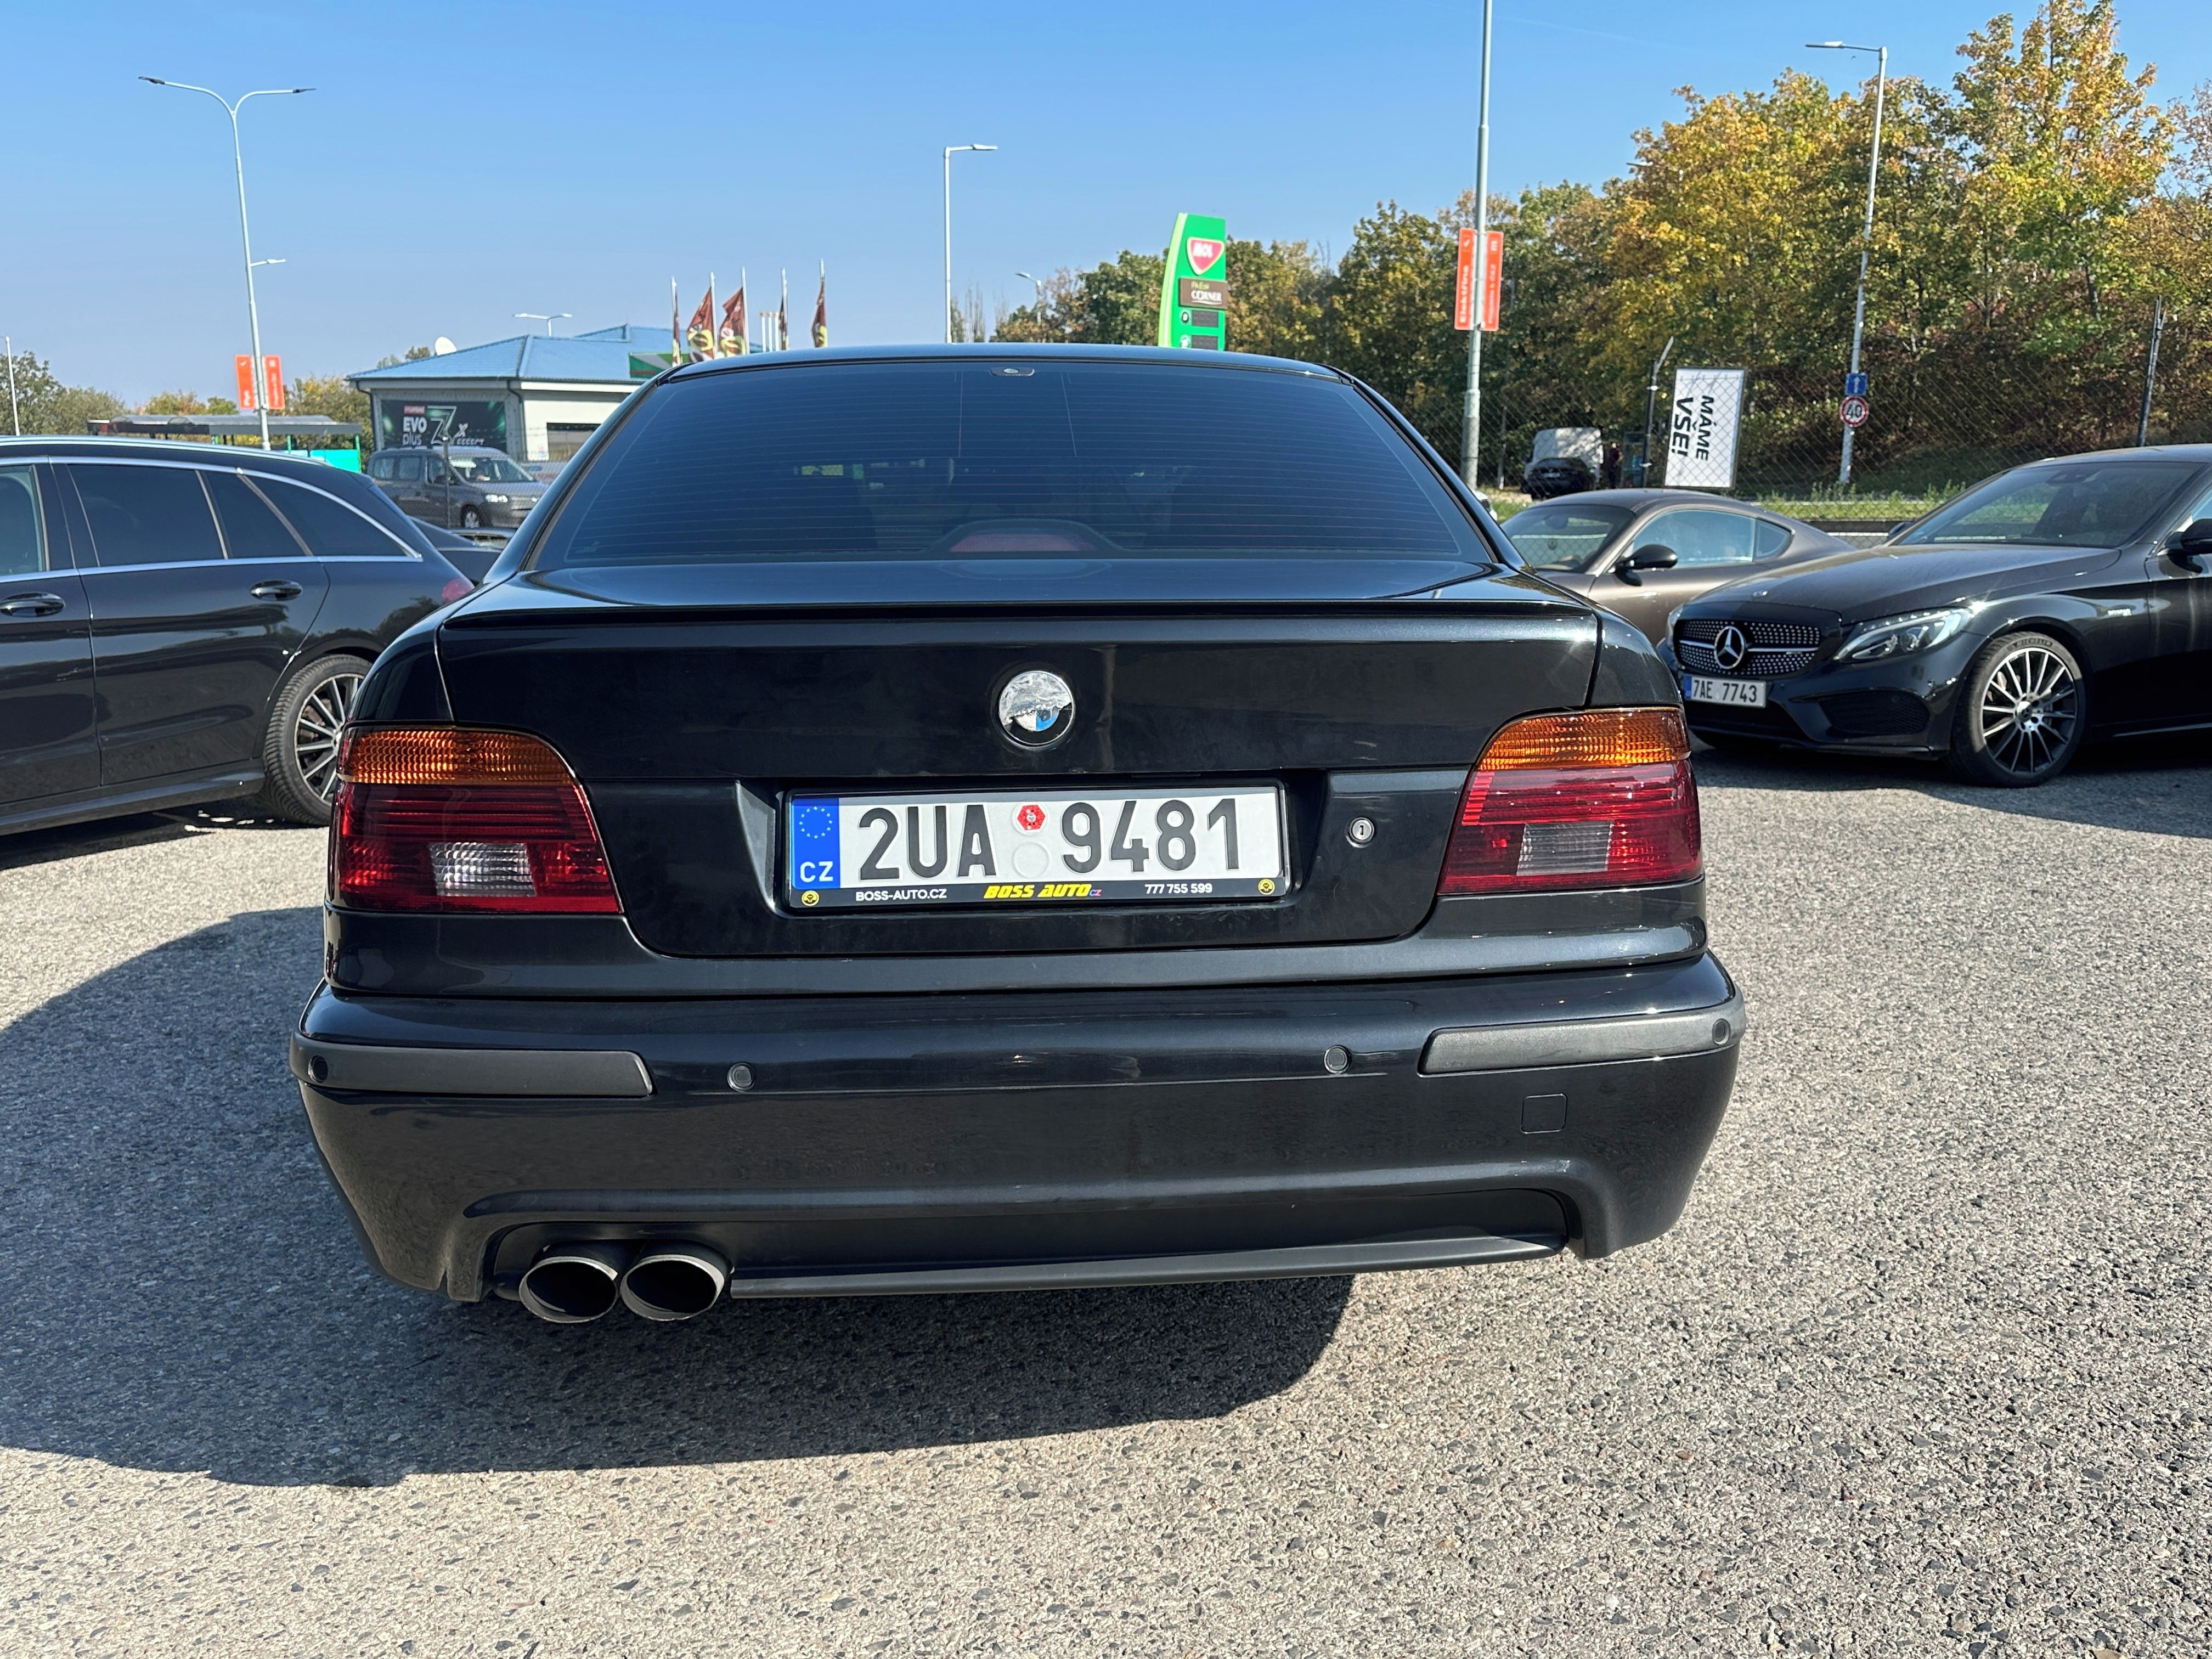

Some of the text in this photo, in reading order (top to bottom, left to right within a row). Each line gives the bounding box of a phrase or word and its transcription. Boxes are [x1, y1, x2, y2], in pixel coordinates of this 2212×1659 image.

[1846, 404, 1863, 418] 40
[403, 416, 427, 433] EVO
[1672, 397, 1697, 456] VŠE!
[1696, 396, 1717, 461] MÁME
[402, 432, 422, 446] plus
[1694, 680, 1757, 703] 7AE 7743
[858, 798, 1239, 880] 2UA 9481
[800, 861, 834, 882] CZ
[856, 889, 947, 901] BOSS-AUTO.CZ
[984, 884, 1035, 899] BOSS
[1037, 884, 1092, 898] AUTO
[1144, 883, 1212, 894] 777 755 599
